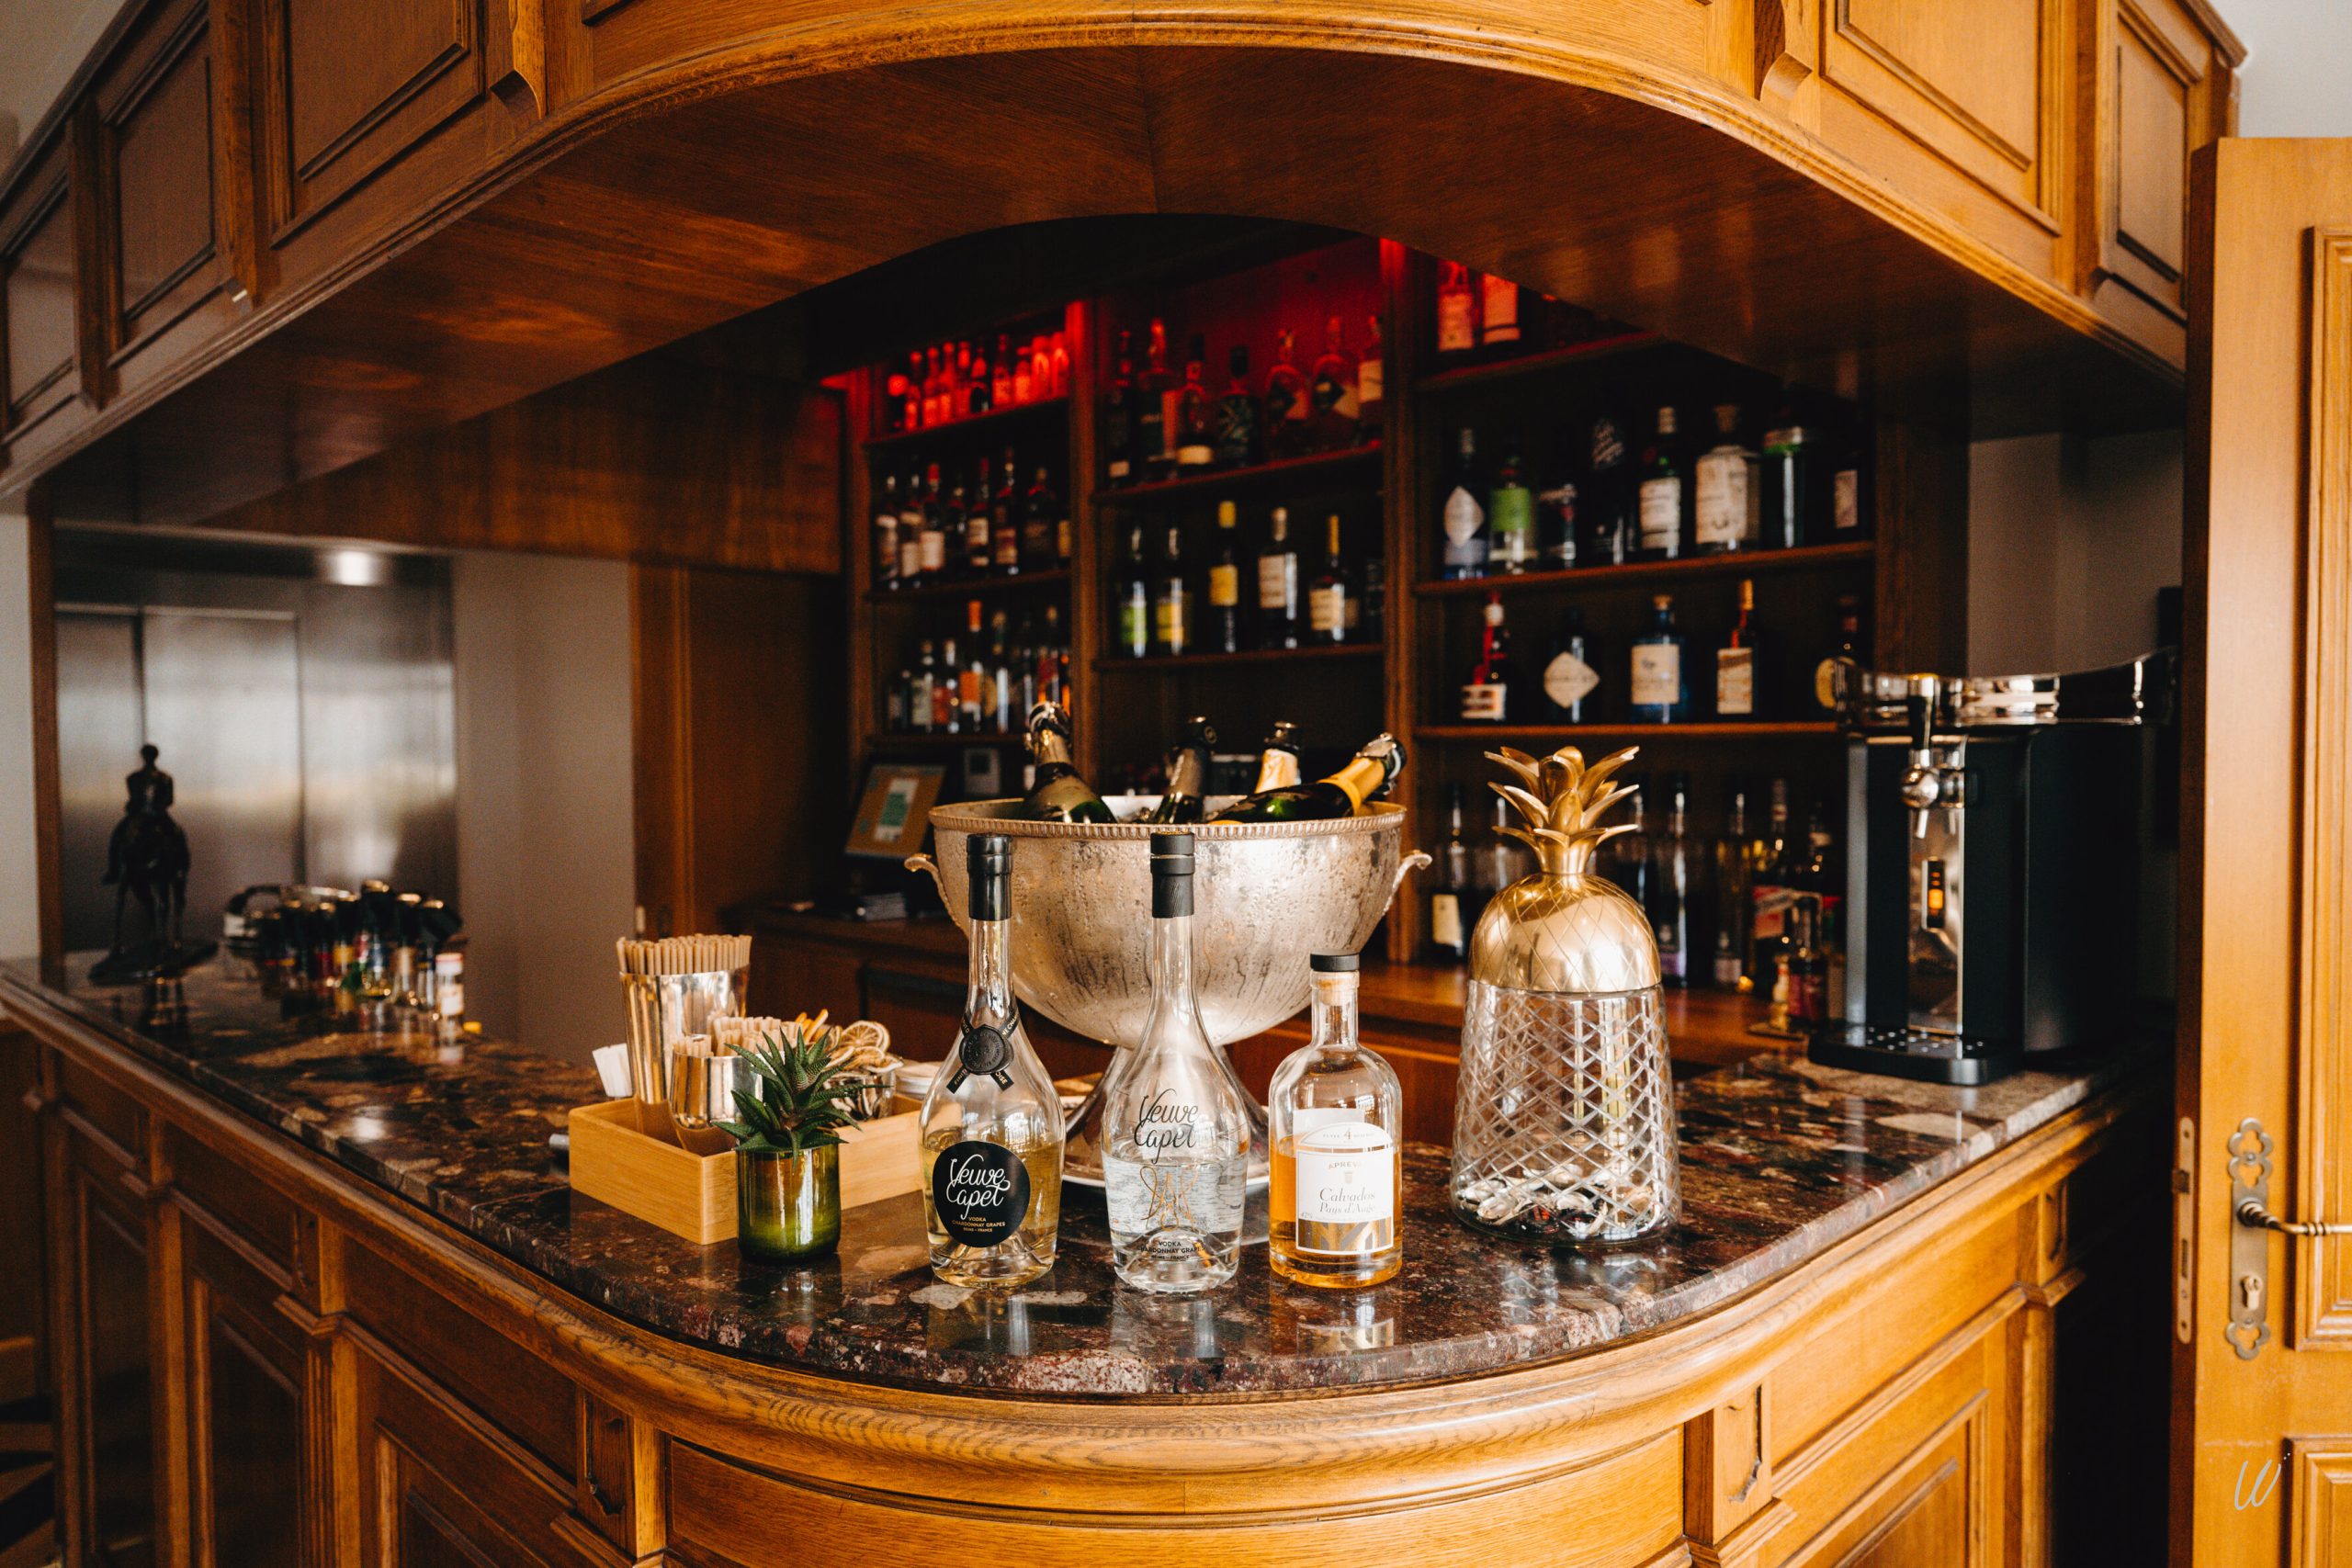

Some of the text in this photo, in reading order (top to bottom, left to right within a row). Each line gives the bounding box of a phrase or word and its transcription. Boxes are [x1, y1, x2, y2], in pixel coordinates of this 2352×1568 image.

[1138, 1089, 1199, 1128] Veuve
[1134, 1118, 1198, 1165] Capet
[949, 1154, 1007, 1188] Veuve
[945, 1179, 1012, 1221] Capet
[1319, 1186, 1376, 1202] Calvados
[1319, 1201, 1342, 1214] Pays
